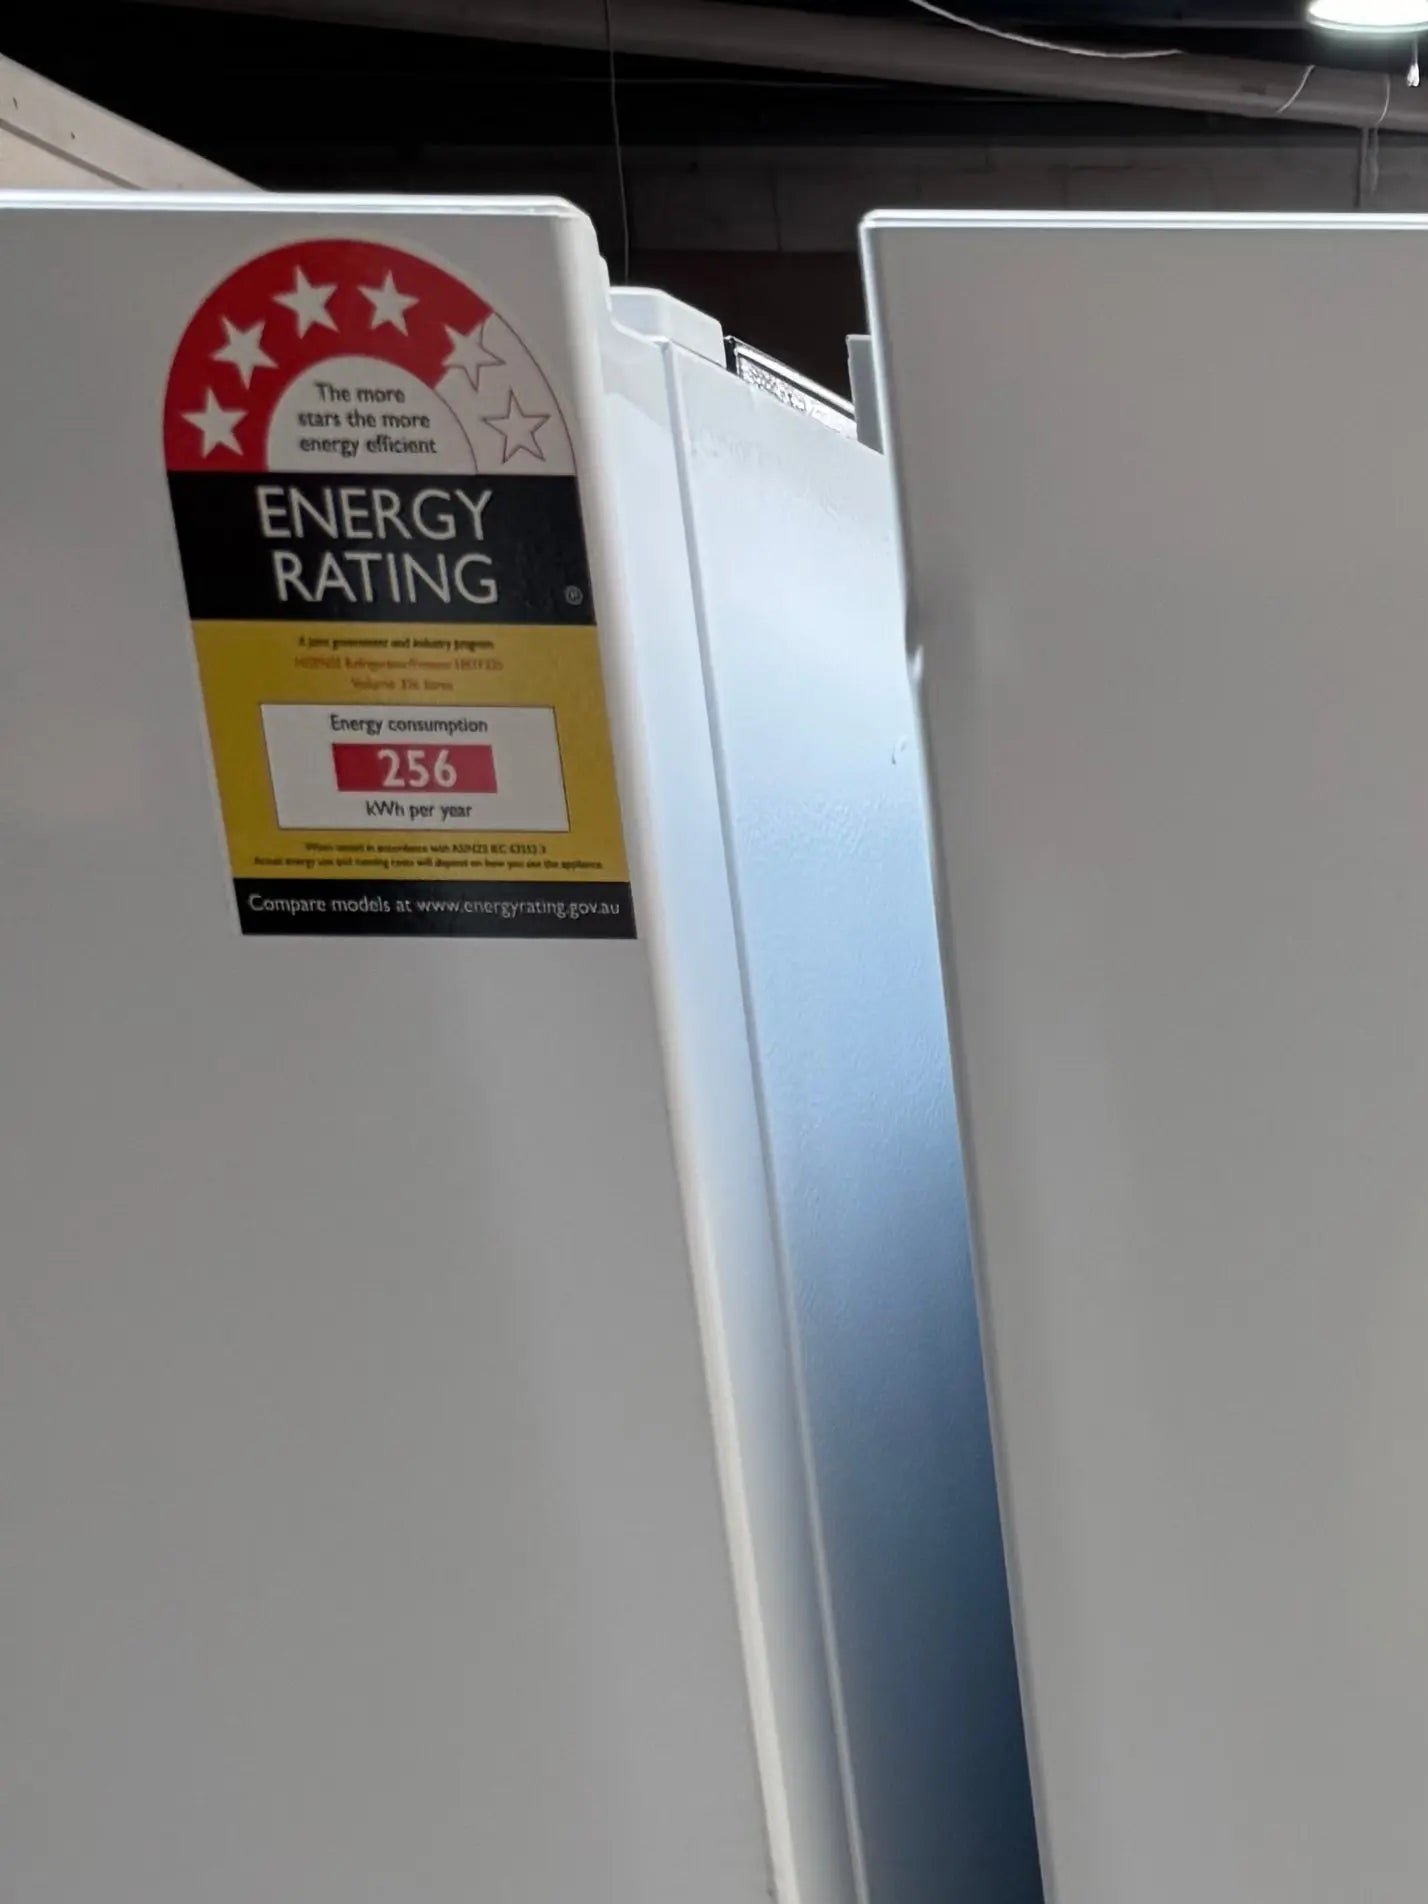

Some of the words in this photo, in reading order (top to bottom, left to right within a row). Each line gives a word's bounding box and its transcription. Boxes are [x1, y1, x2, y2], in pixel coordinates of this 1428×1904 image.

[314, 381, 351, 402] The
[356, 387, 406, 404] more
[297, 411, 342, 428] stars
[346, 408, 377, 428] the
[382, 415, 431, 429] more
[299, 437, 360, 458] energy
[366, 435, 437, 454] efficient
[256, 485, 493, 541] ENERGY
[273, 550, 498, 605] RATING
[330, 714, 384, 735] Energy
[388, 717, 489, 737] consumption
[376, 748, 458, 788] 256
[366, 800, 406, 817] kWh
[409, 803, 435, 821] per
[440, 804, 473, 822] year
[248, 893, 327, 916] Compare
[331, 896, 391, 913] models
[395, 898, 412, 912] at
[416, 899, 620, 920] www.energyrating.gov.au
